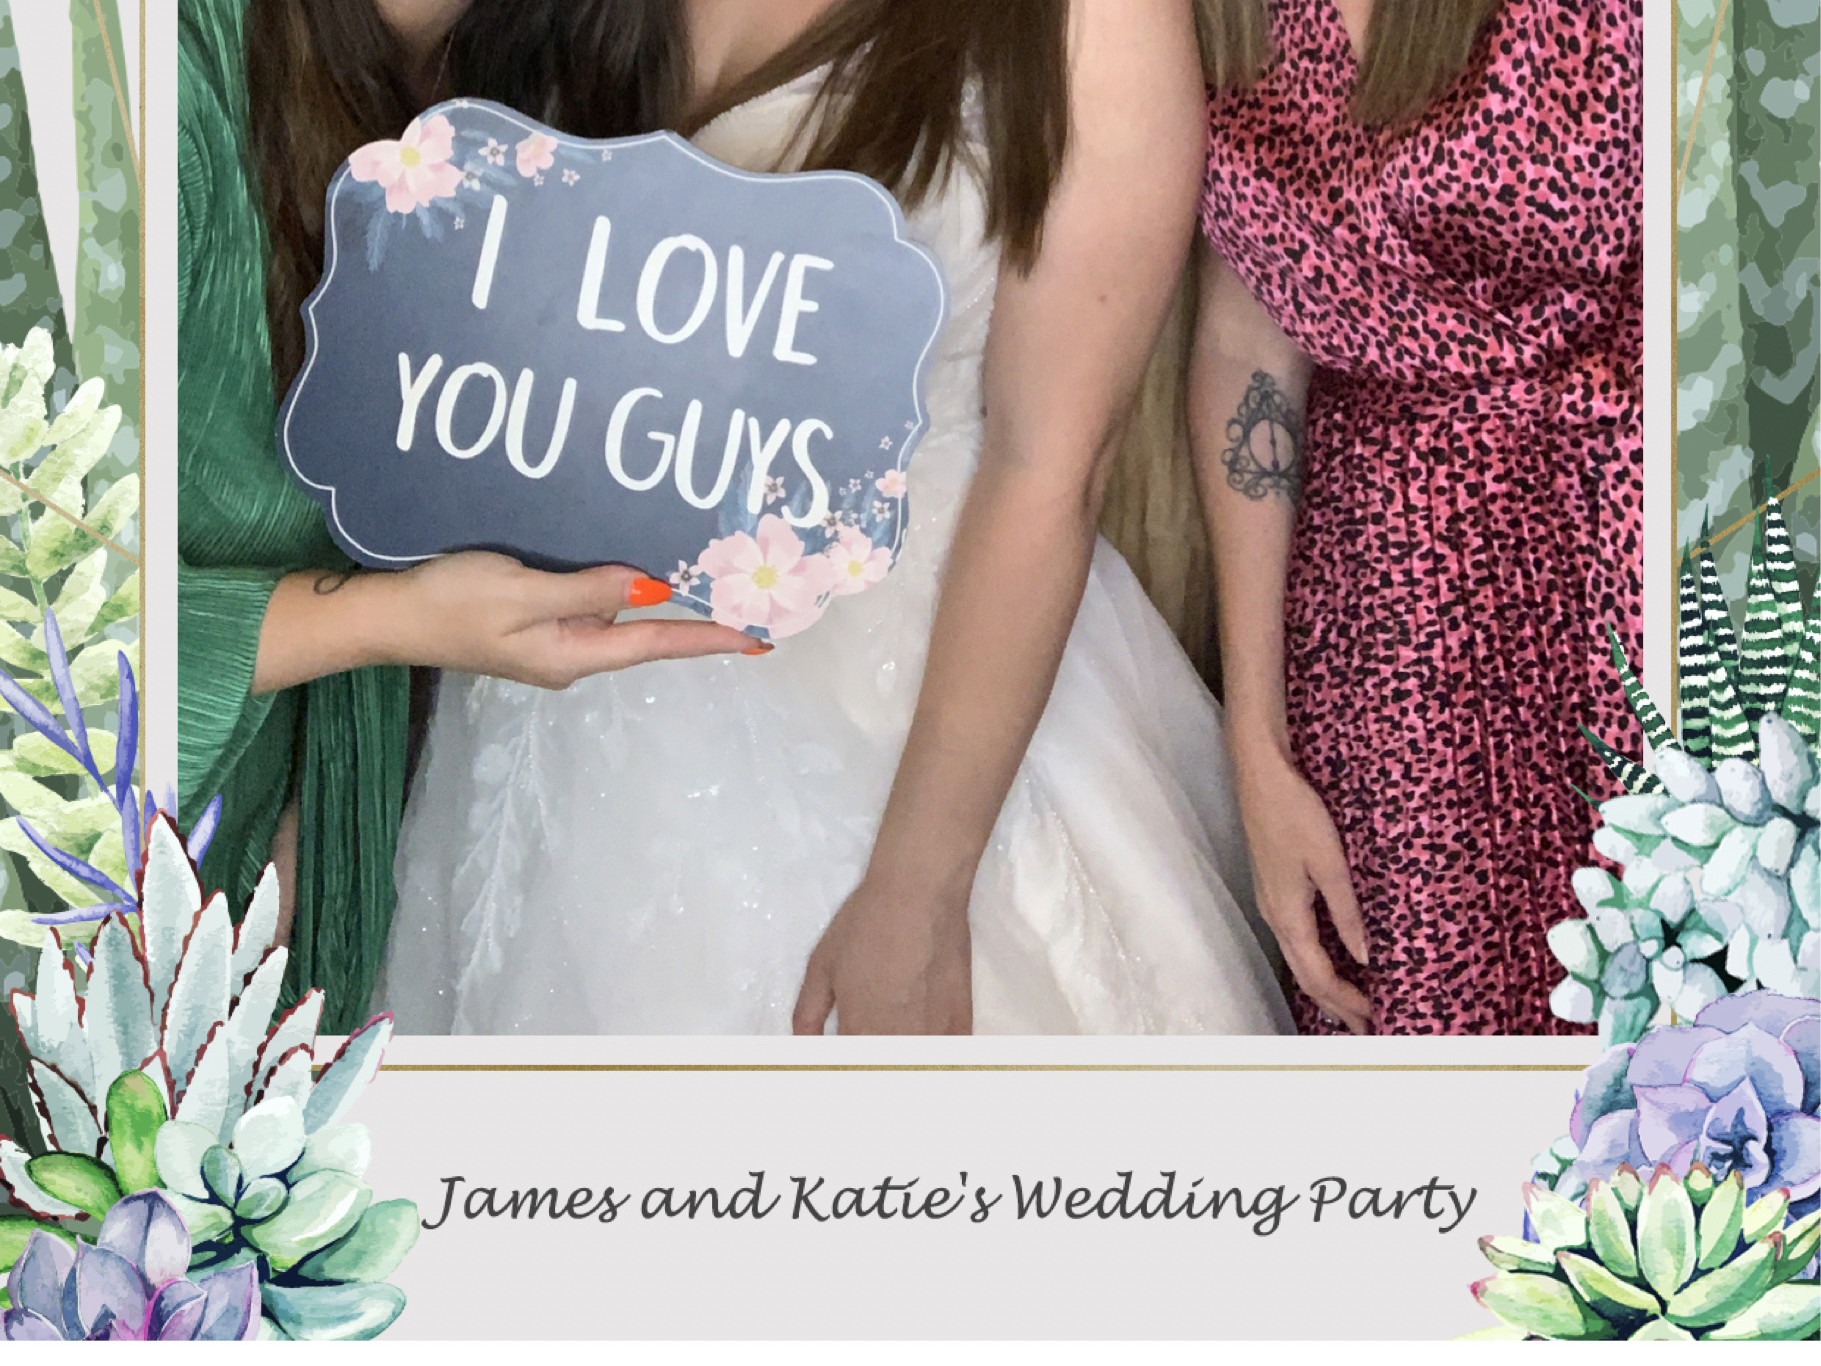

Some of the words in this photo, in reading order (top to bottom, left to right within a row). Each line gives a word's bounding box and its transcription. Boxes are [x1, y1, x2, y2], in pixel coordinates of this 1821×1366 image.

[471, 193, 509, 311] I
[576, 214, 836, 366] LOVE
[396, 351, 578, 479] YOU
[604, 386, 834, 528] GUYS
